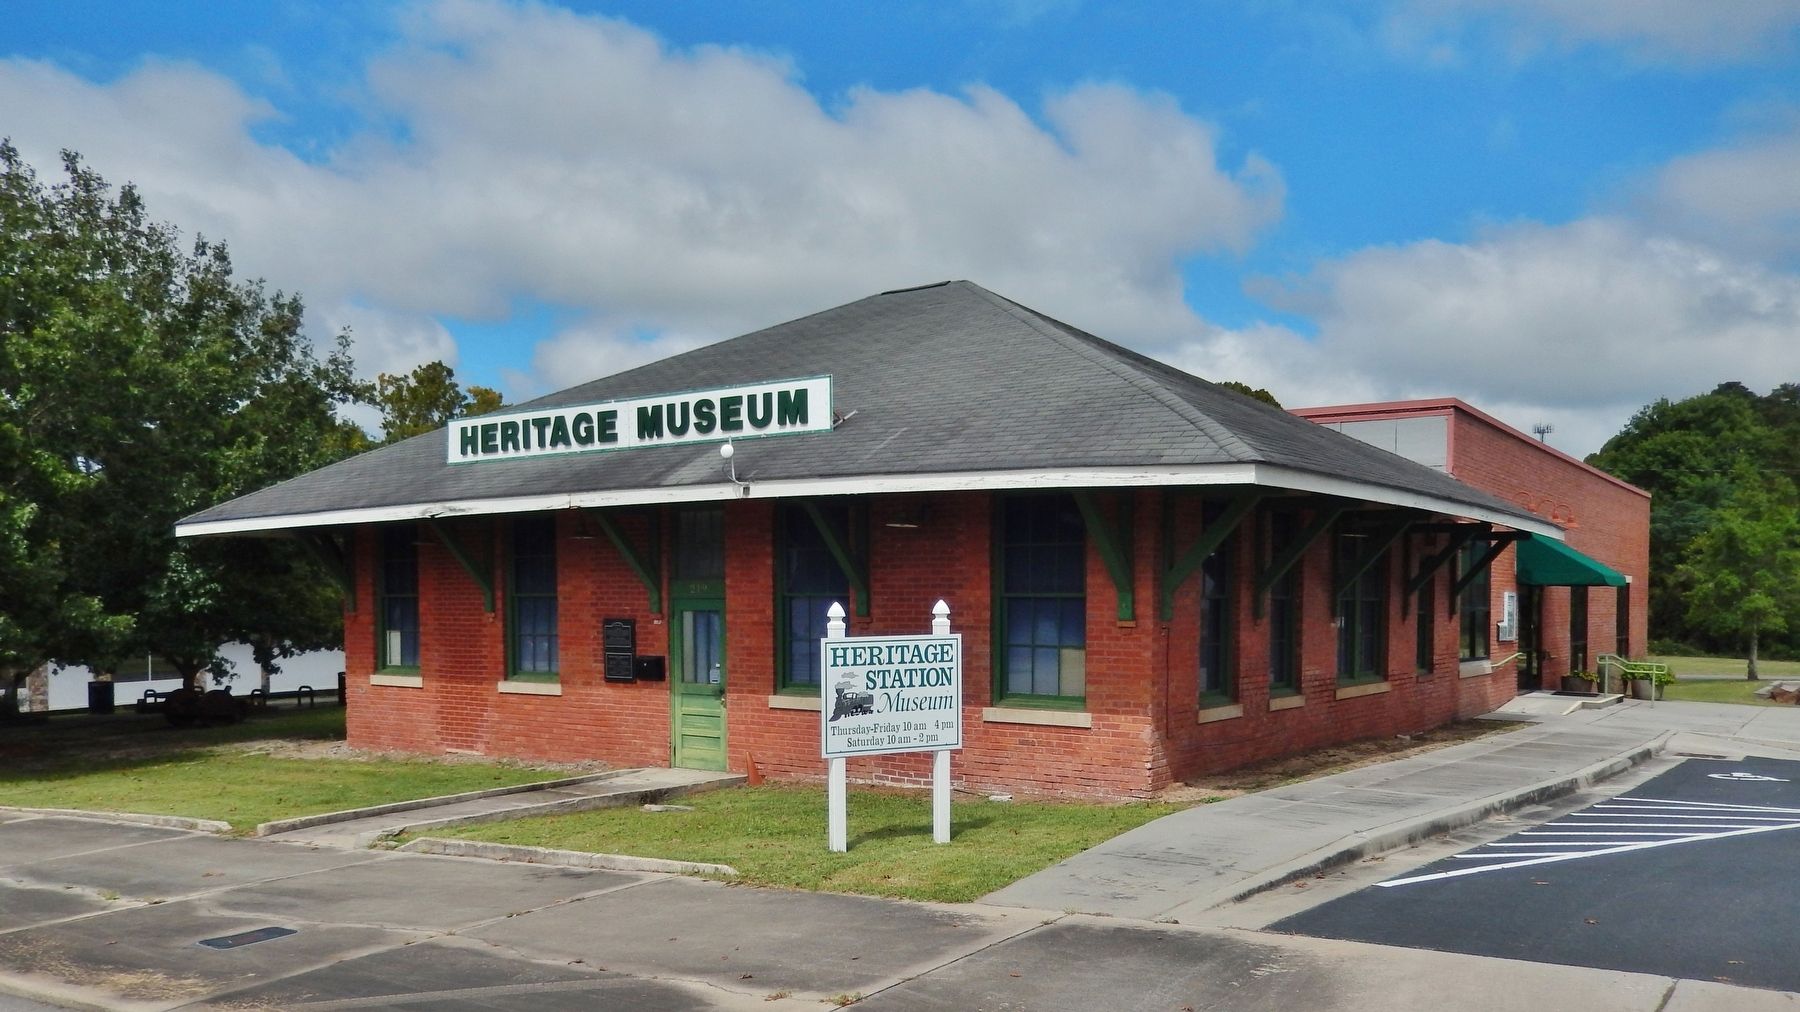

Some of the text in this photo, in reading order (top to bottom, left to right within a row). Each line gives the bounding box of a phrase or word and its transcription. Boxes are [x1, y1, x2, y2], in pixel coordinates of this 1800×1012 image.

[460, 388, 809, 456] HERITAGE MUSEUM
[830, 643, 954, 668] HERITAGE
[865, 667, 954, 691] STATION
[876, 690, 953, 714] Museum
[830, 723, 901, 736] Thursday-Friday
[903, 722, 912, 731] 10
[934, 720, 940, 729] 4
[941, 721, 954, 730] pm
[847, 735, 886, 748] Saturday
[887, 734, 896, 744] 10
[897, 736, 911, 744] am
[919, 733, 924, 742] 2
[925, 734, 939, 743] pm
